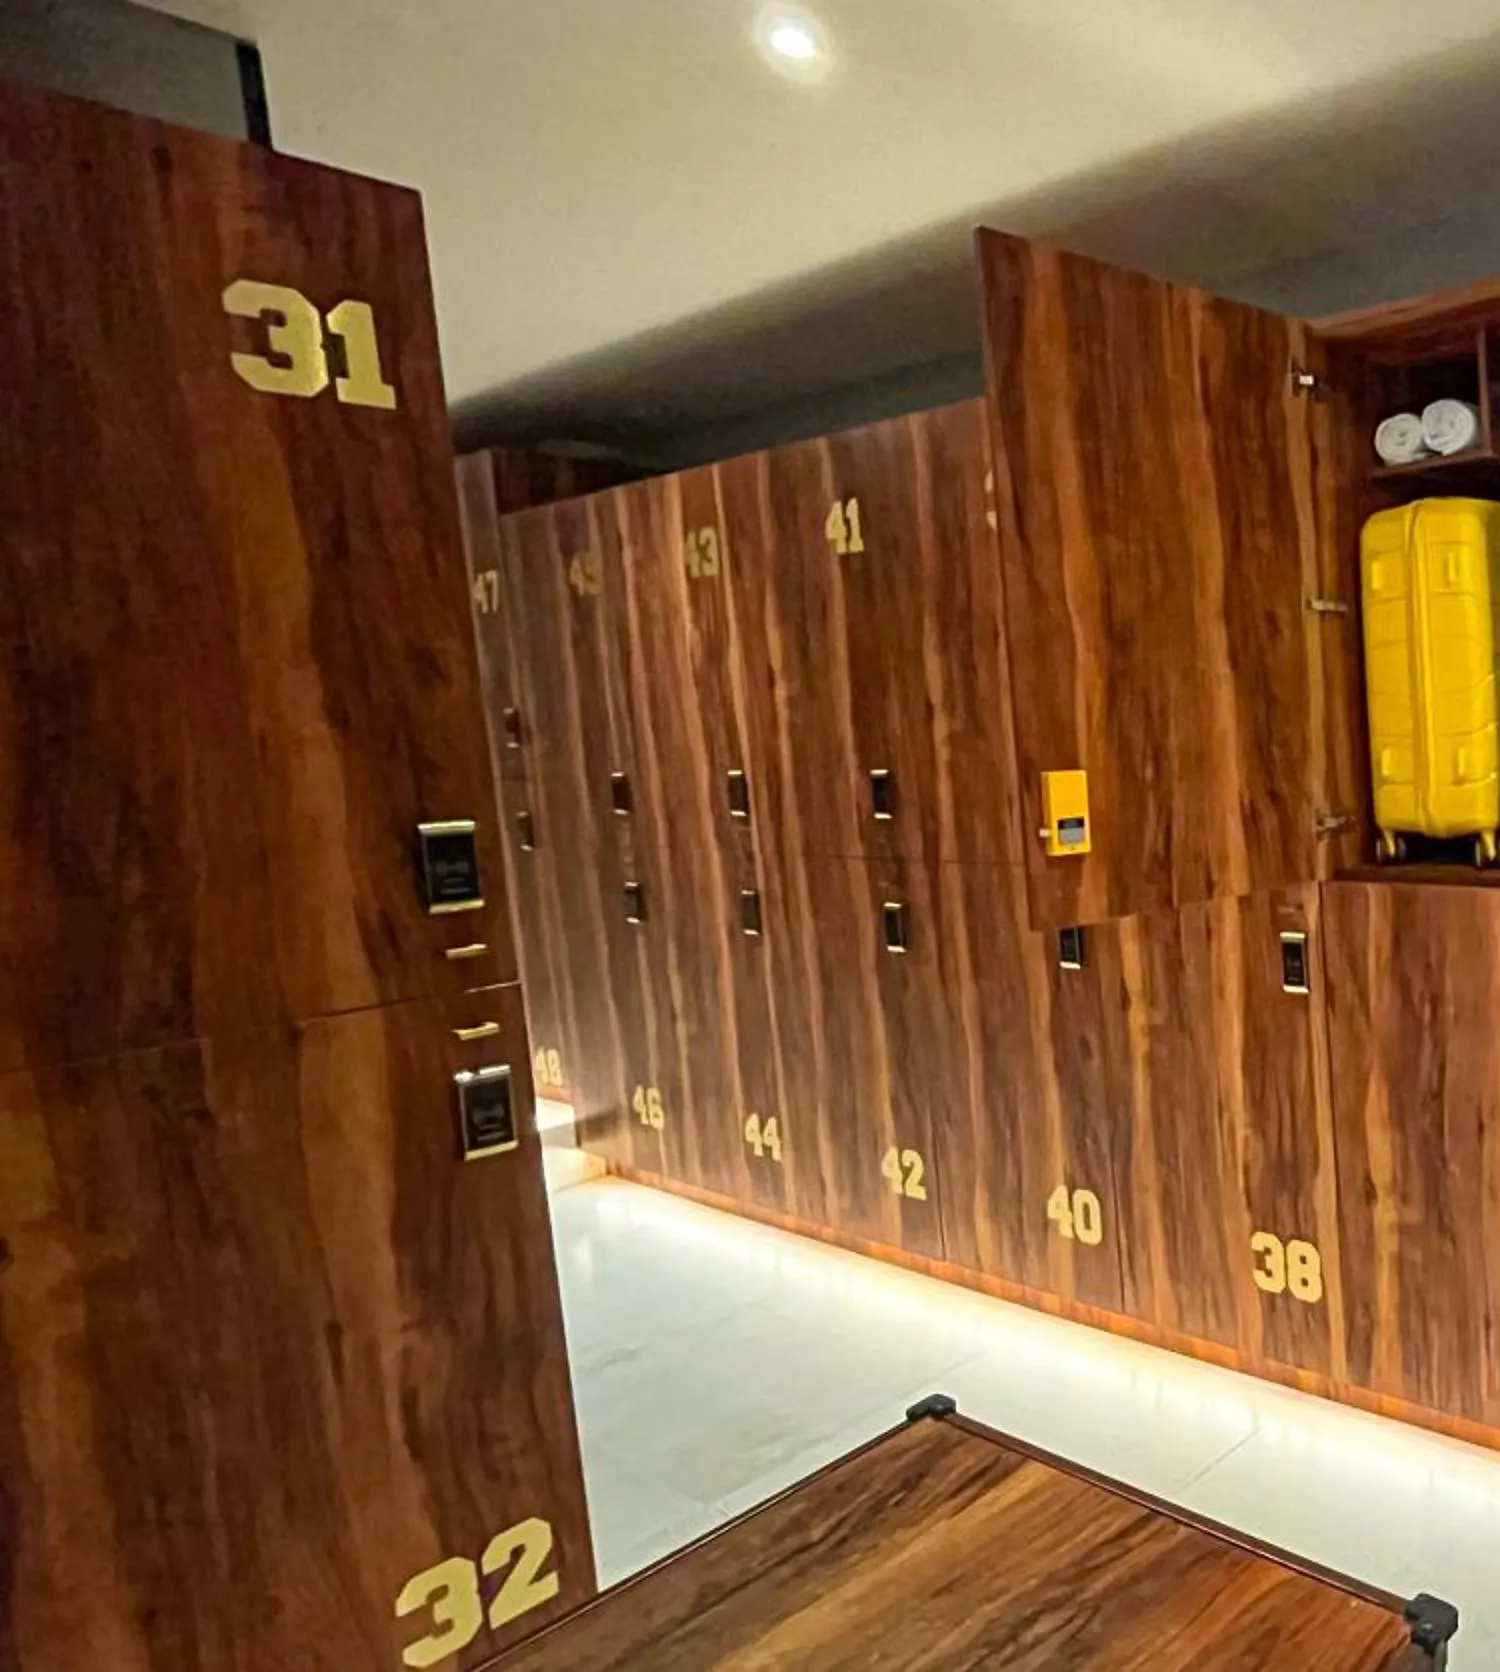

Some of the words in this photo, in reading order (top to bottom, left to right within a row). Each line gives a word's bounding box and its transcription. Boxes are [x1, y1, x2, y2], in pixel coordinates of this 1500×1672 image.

[222, 279, 396, 410] 31
[683, 527, 719, 579] 43
[825, 498, 864, 555] 41
[471, 569, 499, 614] 47
[534, 1047, 562, 1086] 48
[632, 1085, 665, 1129] 46
[745, 1113, 782, 1161] 44
[881, 1146, 927, 1200] 42
[1047, 1184, 1103, 1246] 40
[1250, 1231, 1323, 1303] 38
[395, 1516, 560, 1669] 32
